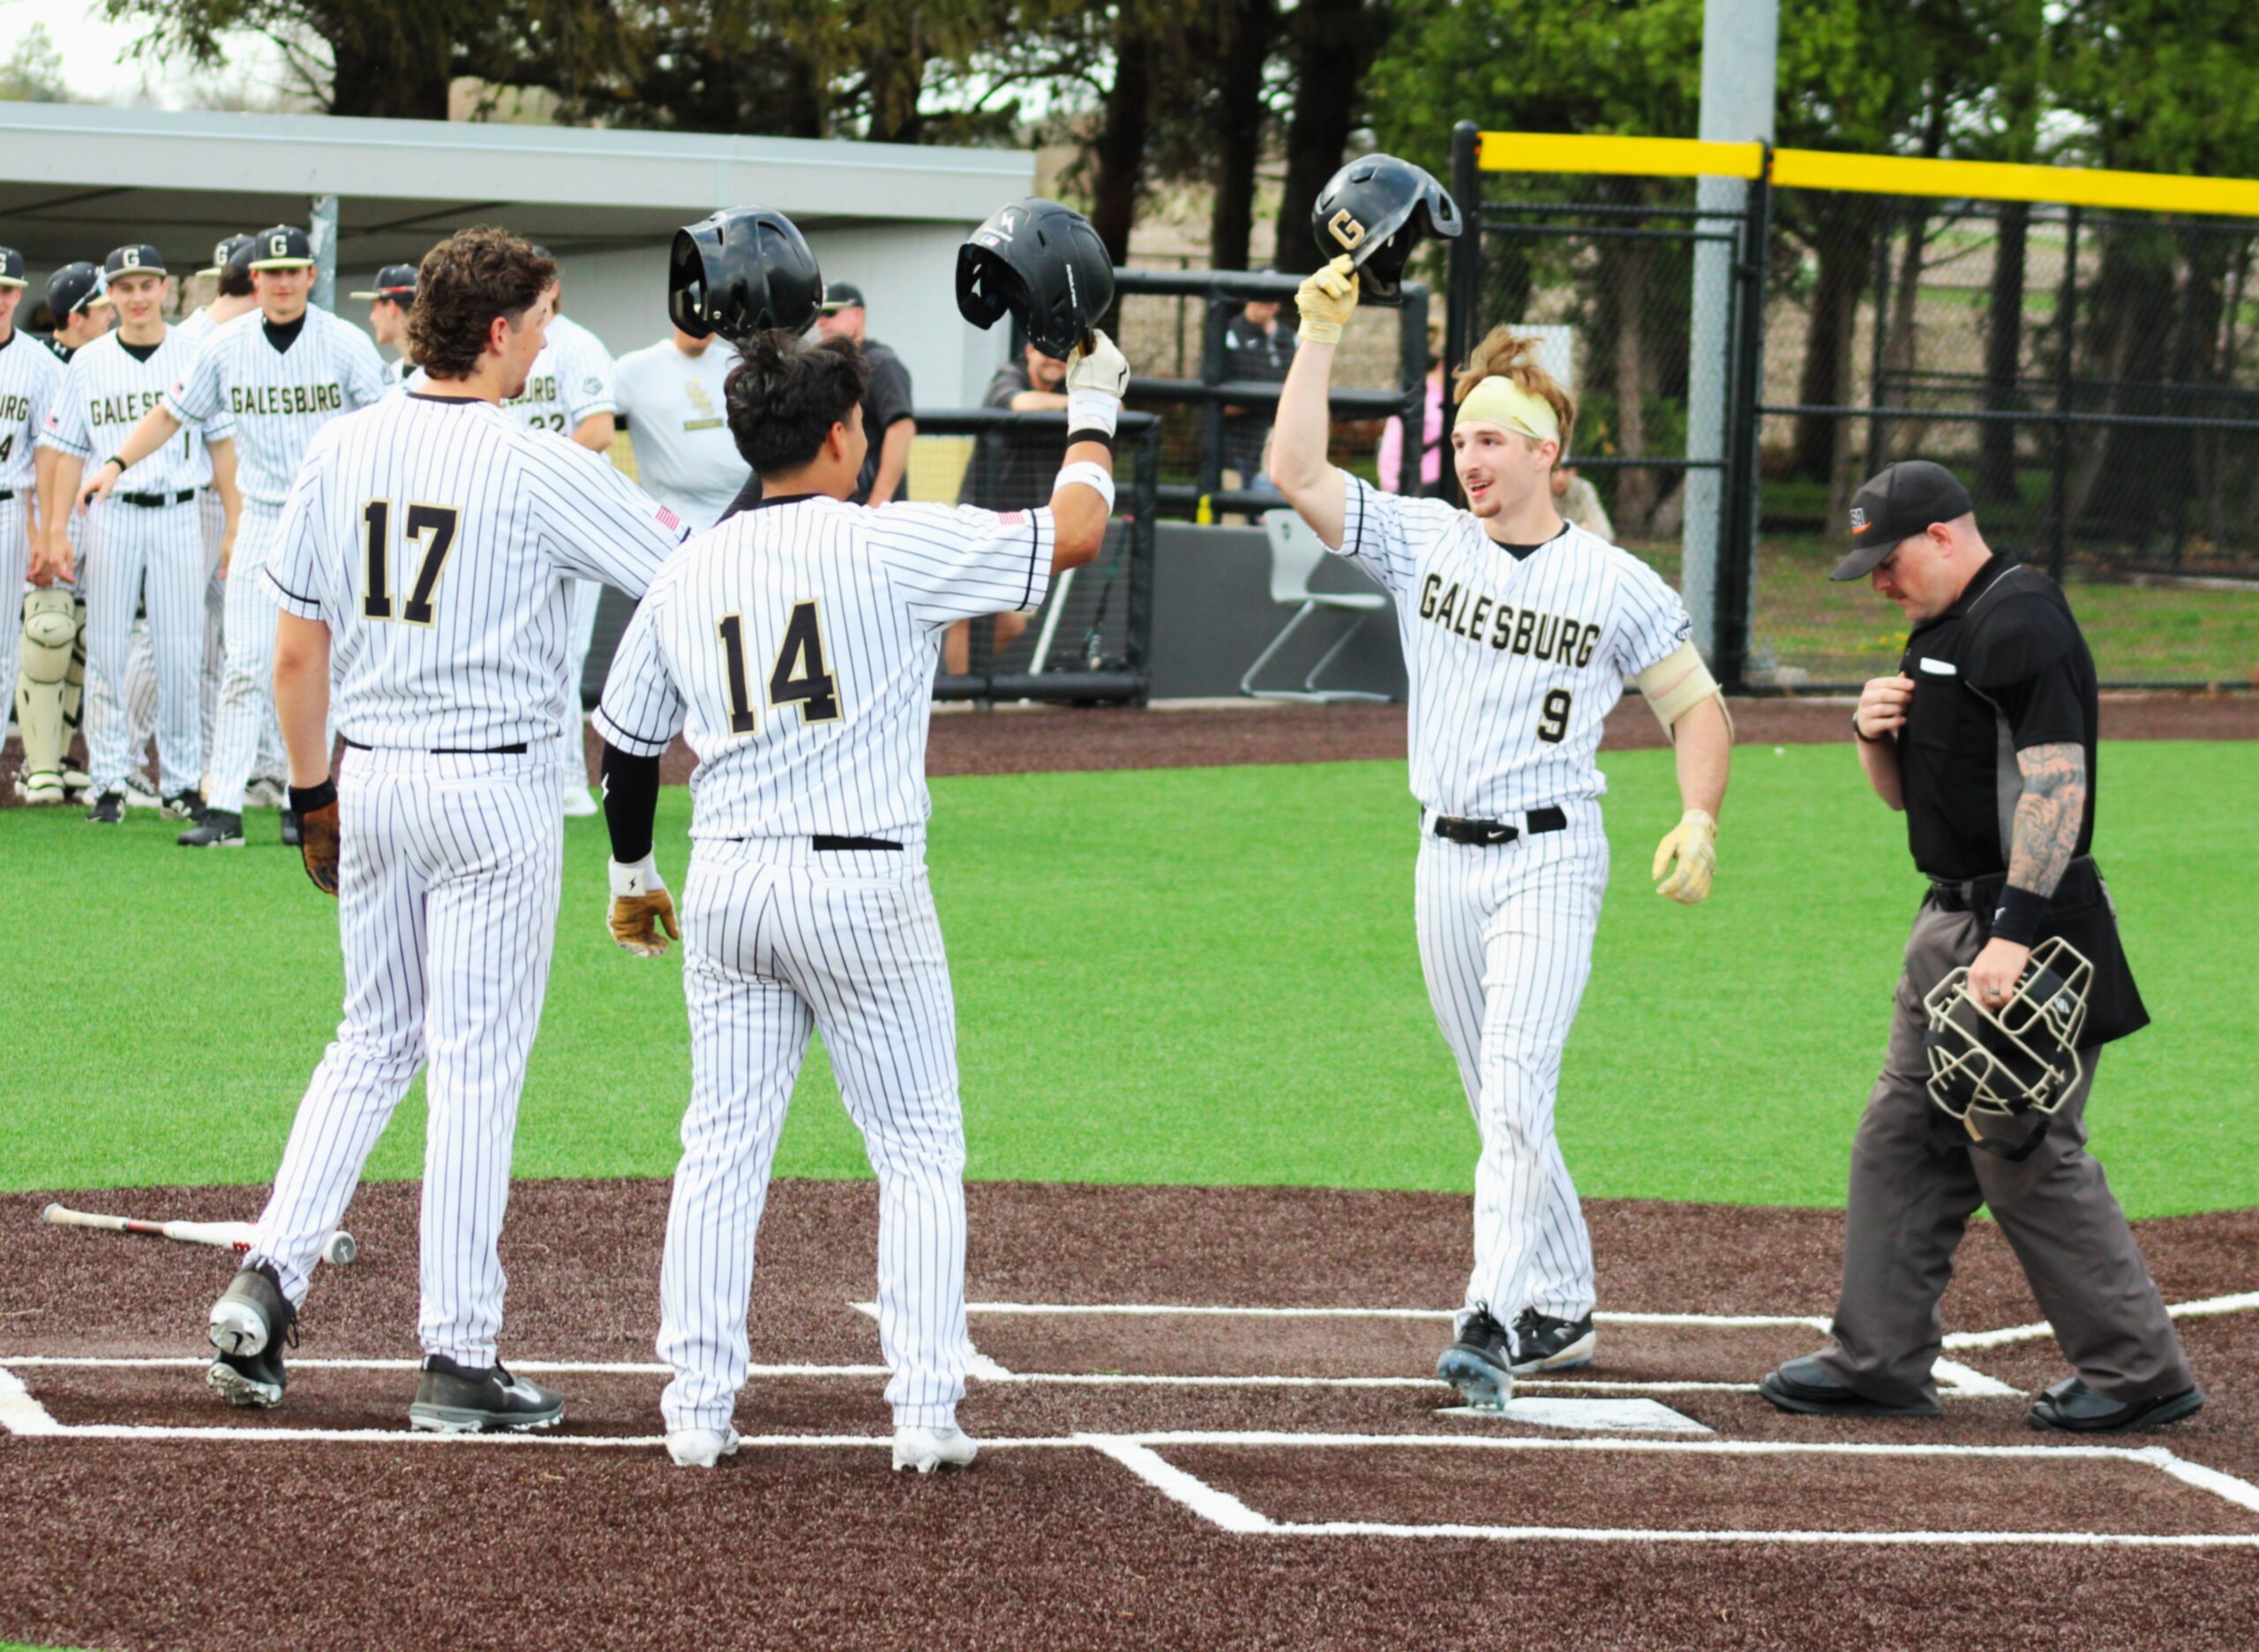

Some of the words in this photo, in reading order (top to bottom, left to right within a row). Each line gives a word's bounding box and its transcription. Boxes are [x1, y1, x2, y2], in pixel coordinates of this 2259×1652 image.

[269, 234, 288, 257] G
[1327, 207, 1366, 251] G
[123, 248, 140, 267] G
[214, 244, 229, 267] G
[230, 382, 342, 415] GALESBURG
[183, 429, 191, 461] 1
[361, 496, 462, 629] 17
[1418, 571, 1602, 670] GALESBURG
[717, 597, 846, 739] 14
[1536, 687, 1572, 745] 9
